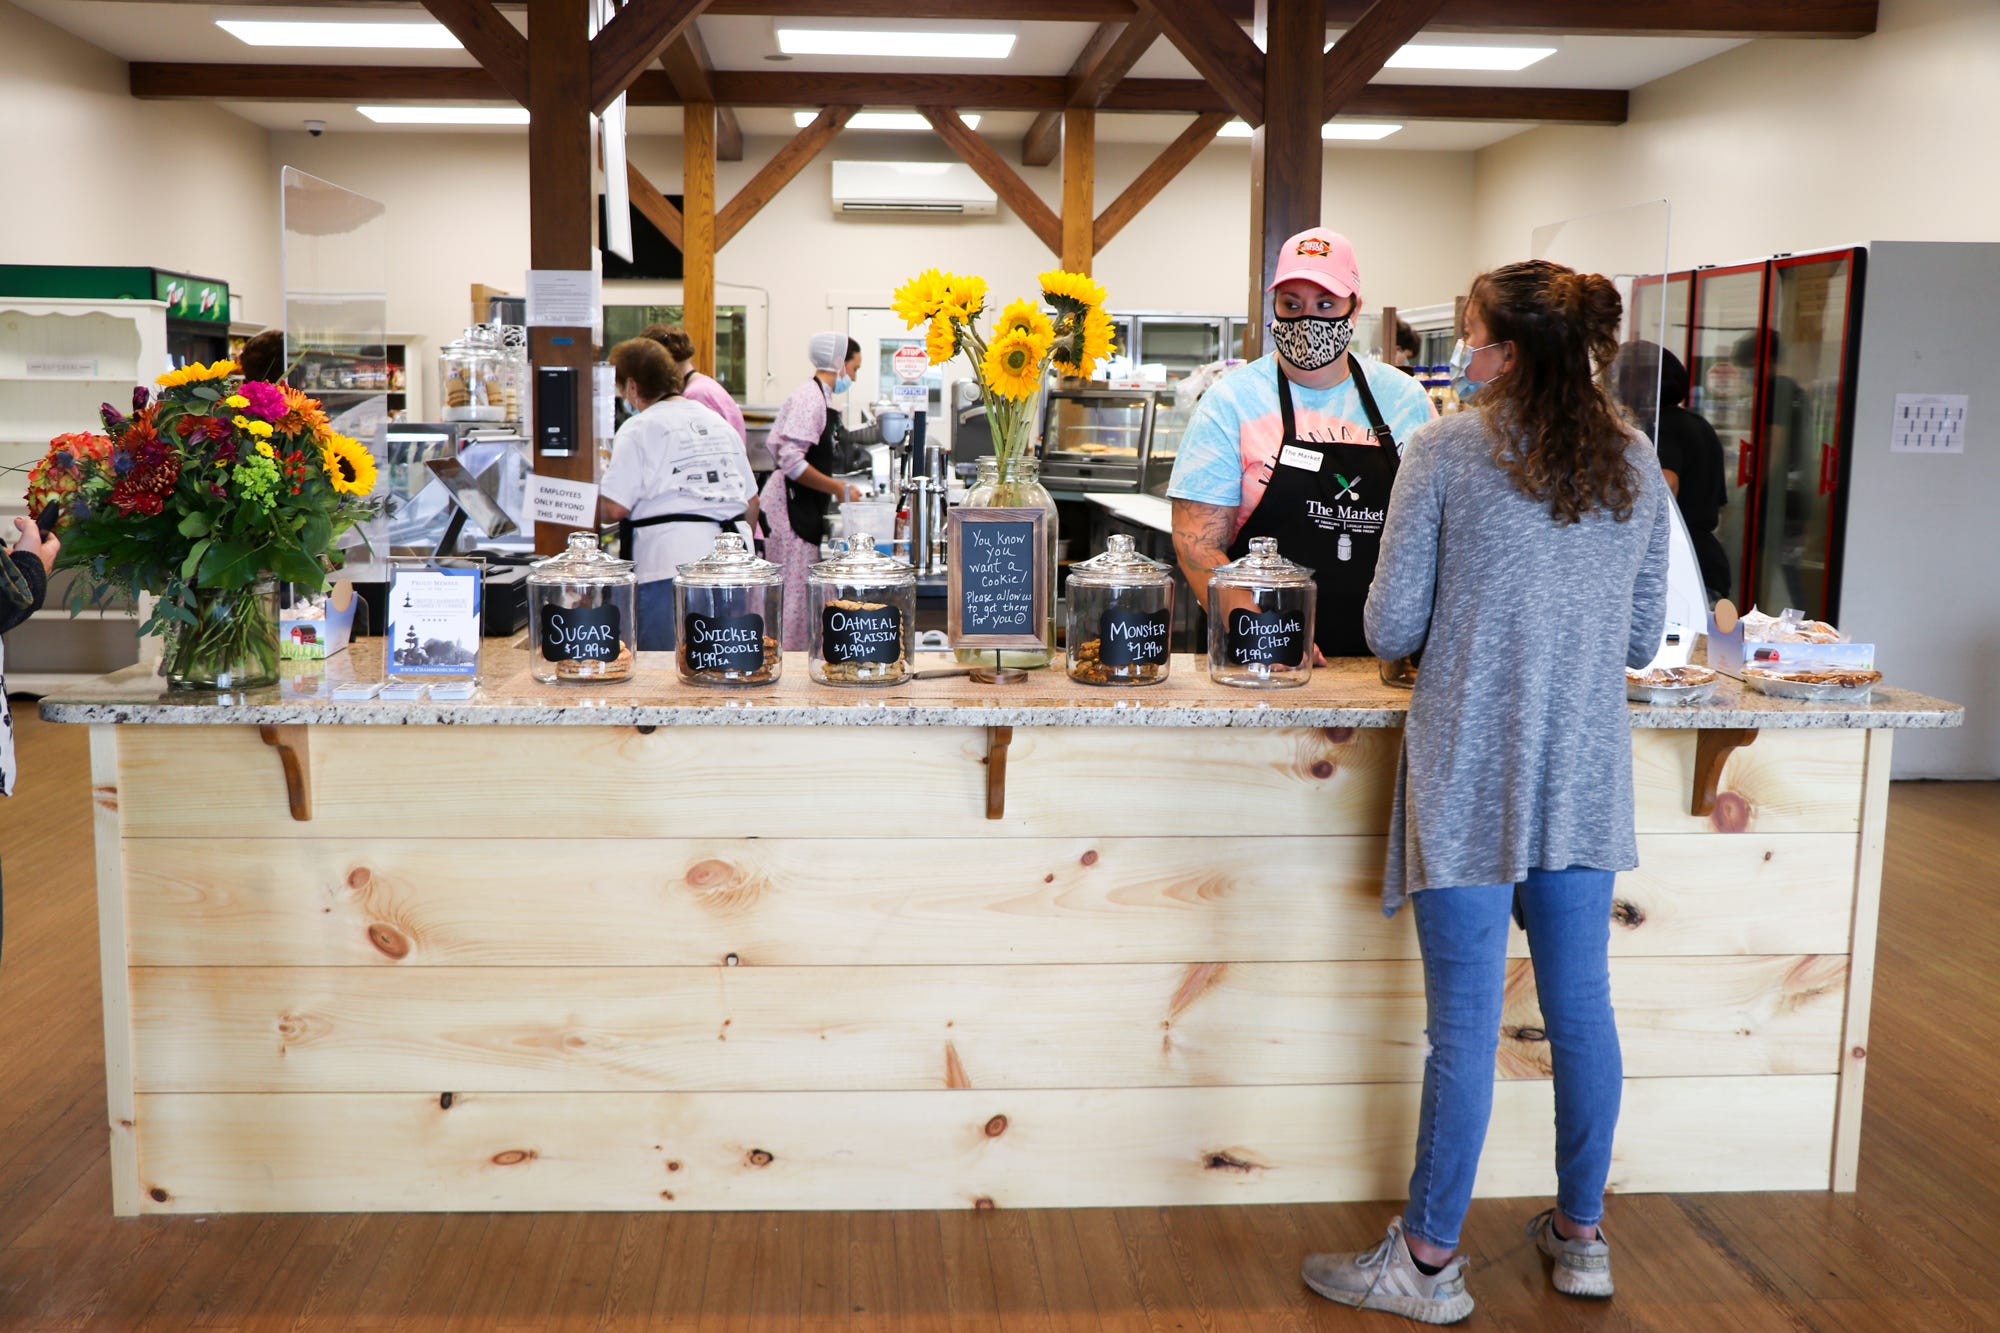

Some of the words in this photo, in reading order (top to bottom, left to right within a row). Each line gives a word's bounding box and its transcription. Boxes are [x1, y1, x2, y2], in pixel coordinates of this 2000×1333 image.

[895, 386, 926, 396] NOTICE
[1284, 448, 1297, 457] The
[1298, 451, 1321, 462] Market
[540, 486, 582, 499] EMPLOYEES
[534, 497, 553, 506] ONLY
[555, 501, 584, 511] BEYOND
[1306, 500, 1333, 517] The
[1337, 505, 1384, 521] Market
[537, 510, 553, 518] THIS
[556, 512, 578, 521] POINT
[973, 529, 992, 547] You
[986, 546, 1016, 563] you
[969, 559, 1002, 573] want
[1007, 561, 1023, 572] a
[966, 591, 994, 603] Please
[996, 590, 1020, 602] allow
[967, 604, 978, 613] to
[984, 602, 998, 619] get
[1002, 602, 1029, 613] them
[972, 614, 988, 627] for
[992, 615, 1013, 629] you
[549, 614, 615, 645] SUGAR
[693, 619, 759, 643] SNICKER
[849, 631, 898, 644] RAISIN
[1257, 636, 1291, 650] CHIP
[712, 643, 761, 655] DOODLE
